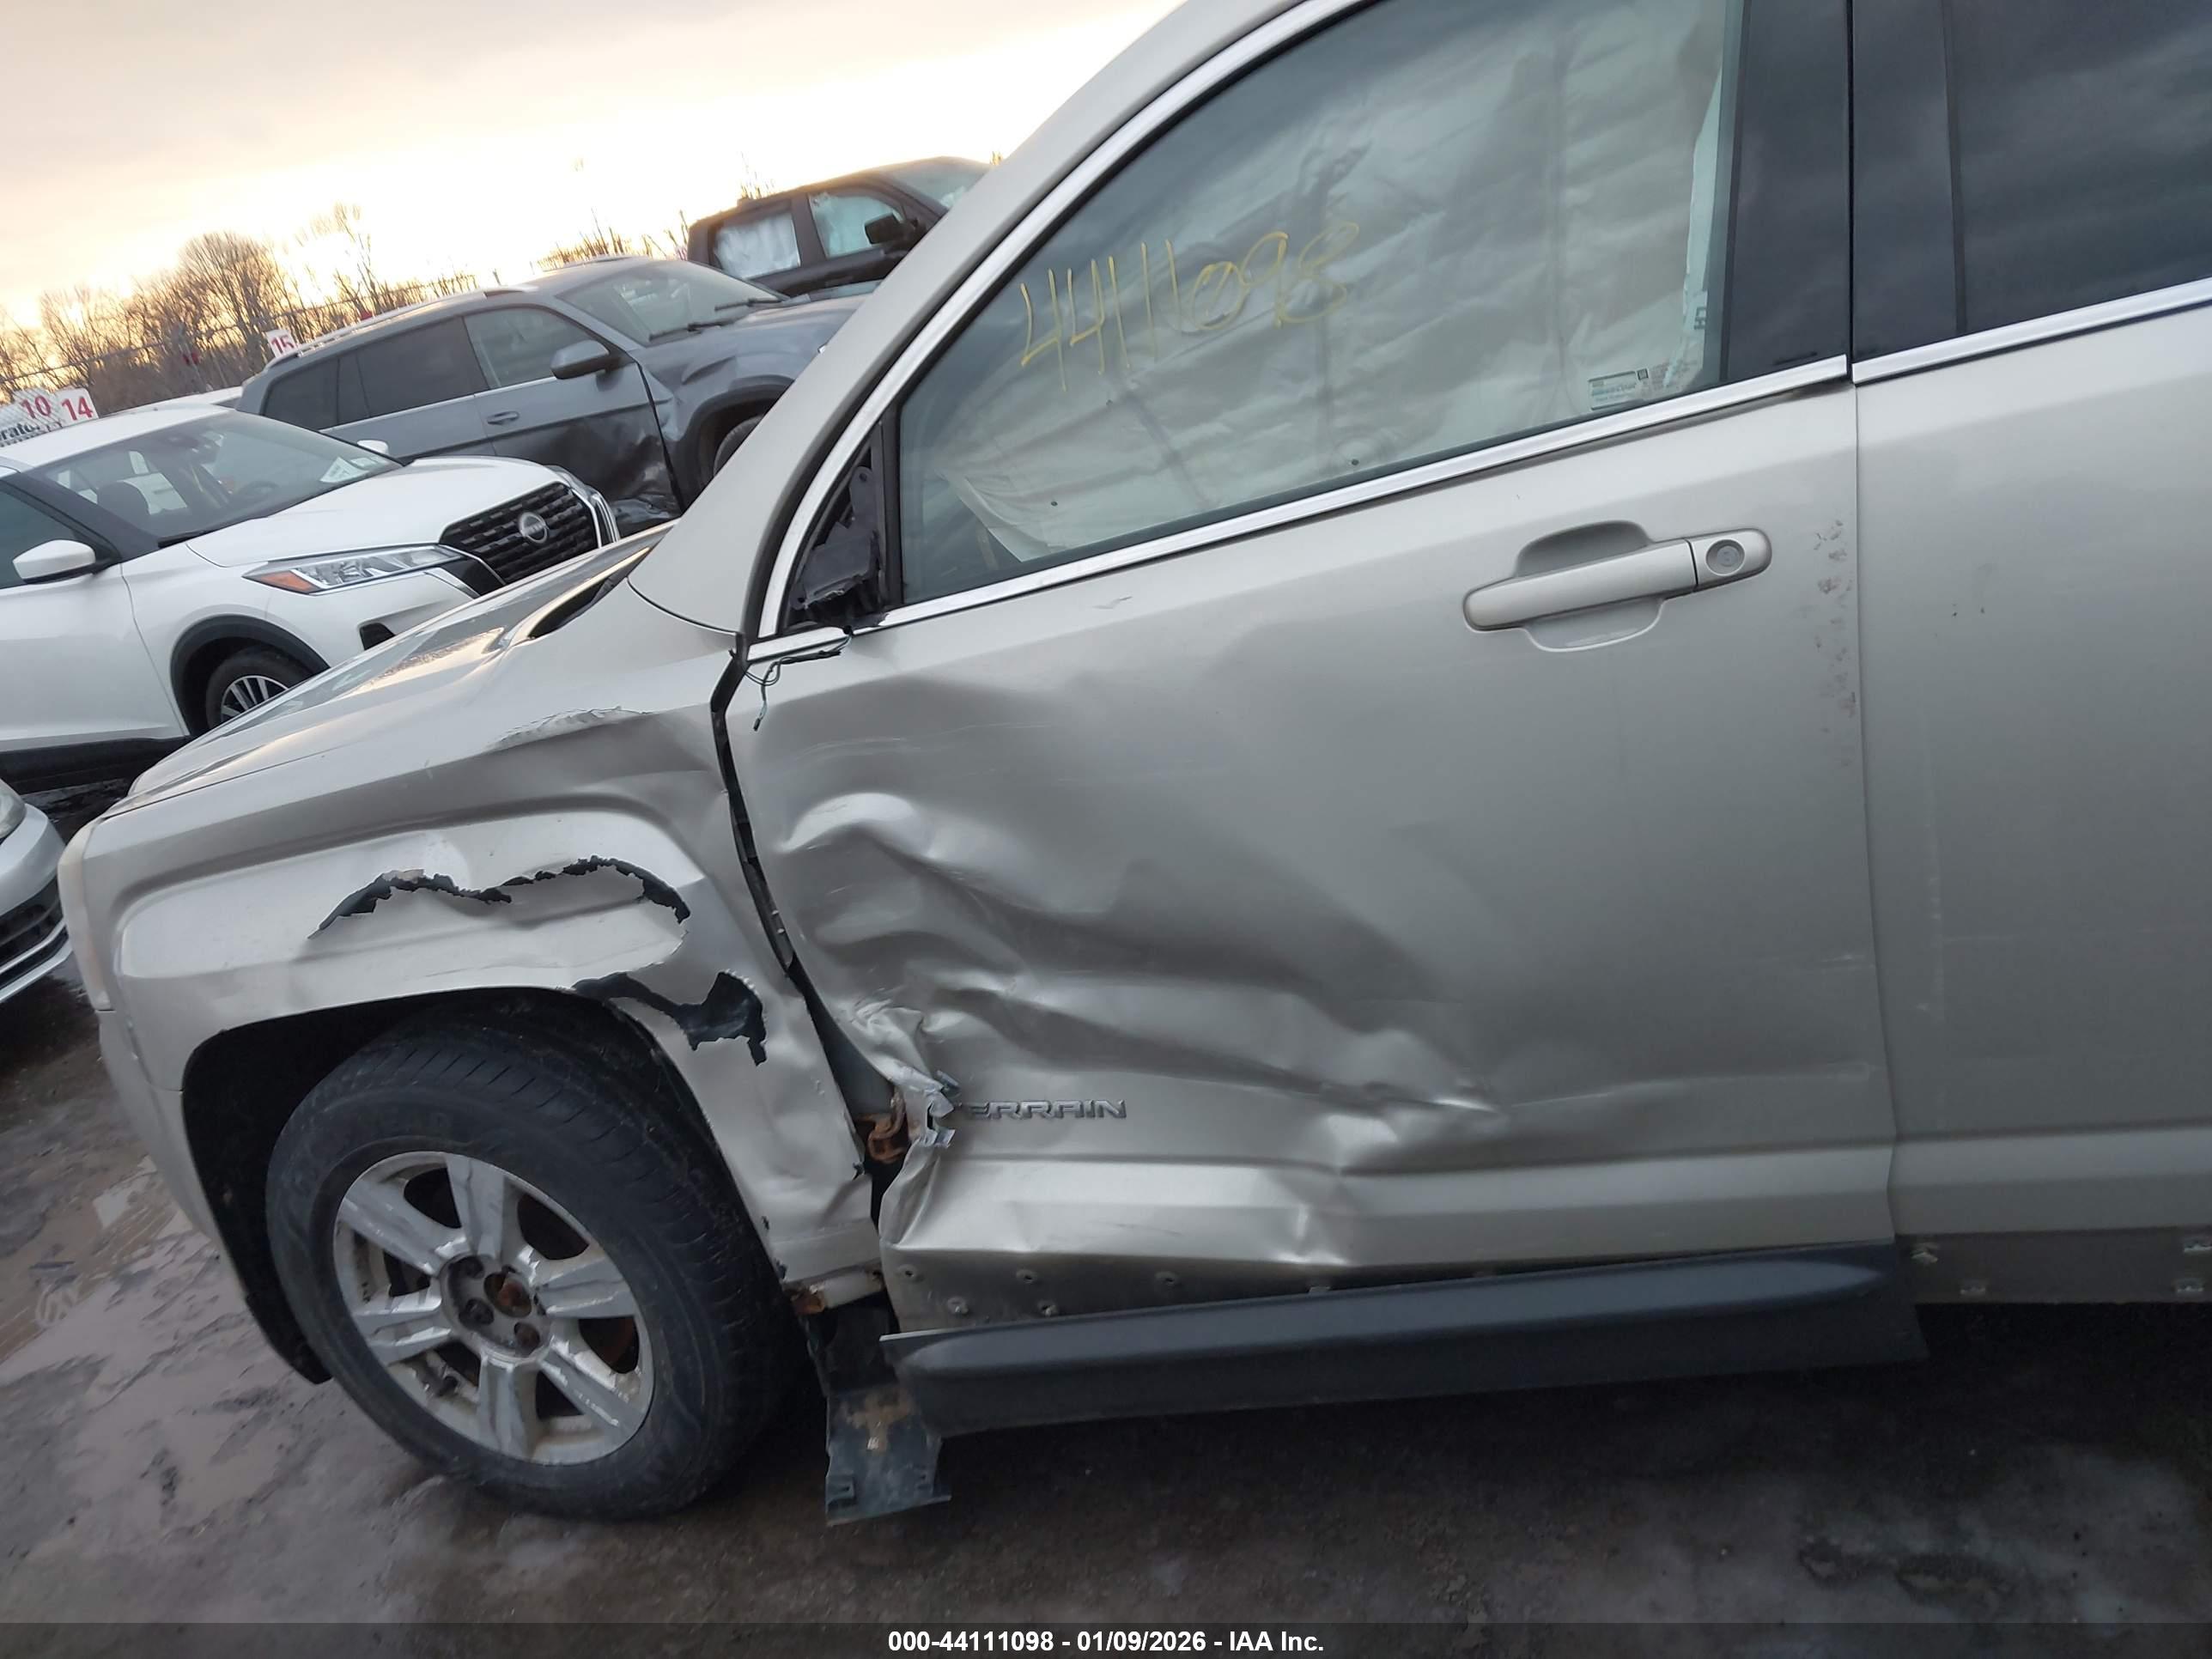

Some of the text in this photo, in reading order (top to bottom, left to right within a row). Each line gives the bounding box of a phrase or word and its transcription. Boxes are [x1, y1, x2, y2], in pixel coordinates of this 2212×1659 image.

[270, 335, 295, 354] 15
[21, 396, 52, 419] 10
[61, 397, 94, 421] 14
[962, 1099, 1127, 1120] ERRAIN
